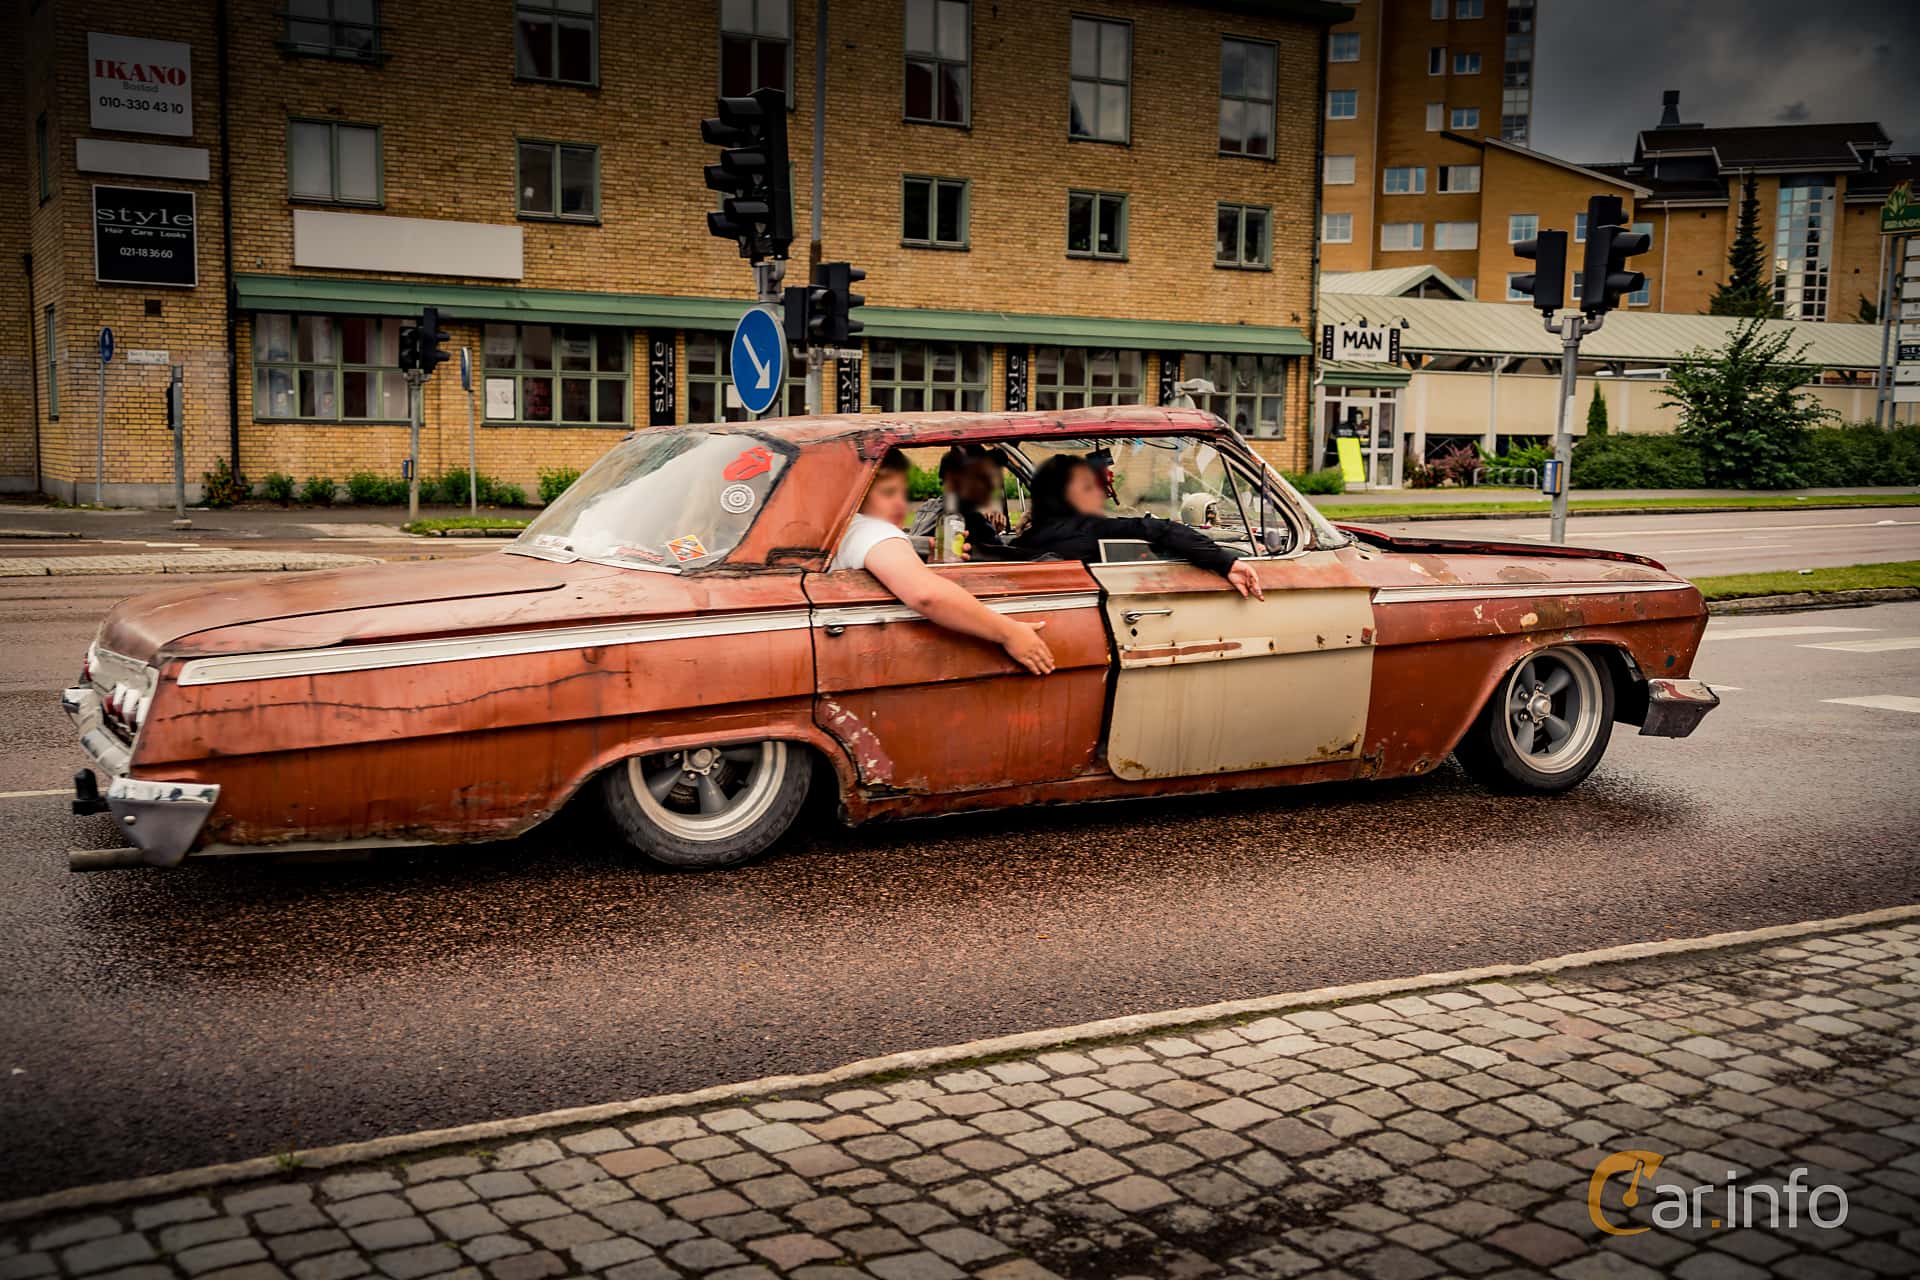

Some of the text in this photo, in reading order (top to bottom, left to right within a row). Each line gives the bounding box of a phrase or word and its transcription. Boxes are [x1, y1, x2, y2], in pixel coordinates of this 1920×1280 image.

[95, 59, 186, 87] IKANO
[99, 96, 184, 114] 010-330 43 10
[97, 207, 193, 226] style
[120, 247, 148, 257] 021-18
[1343, 331, 1382, 350] MAN
[652, 341, 665, 413] style
